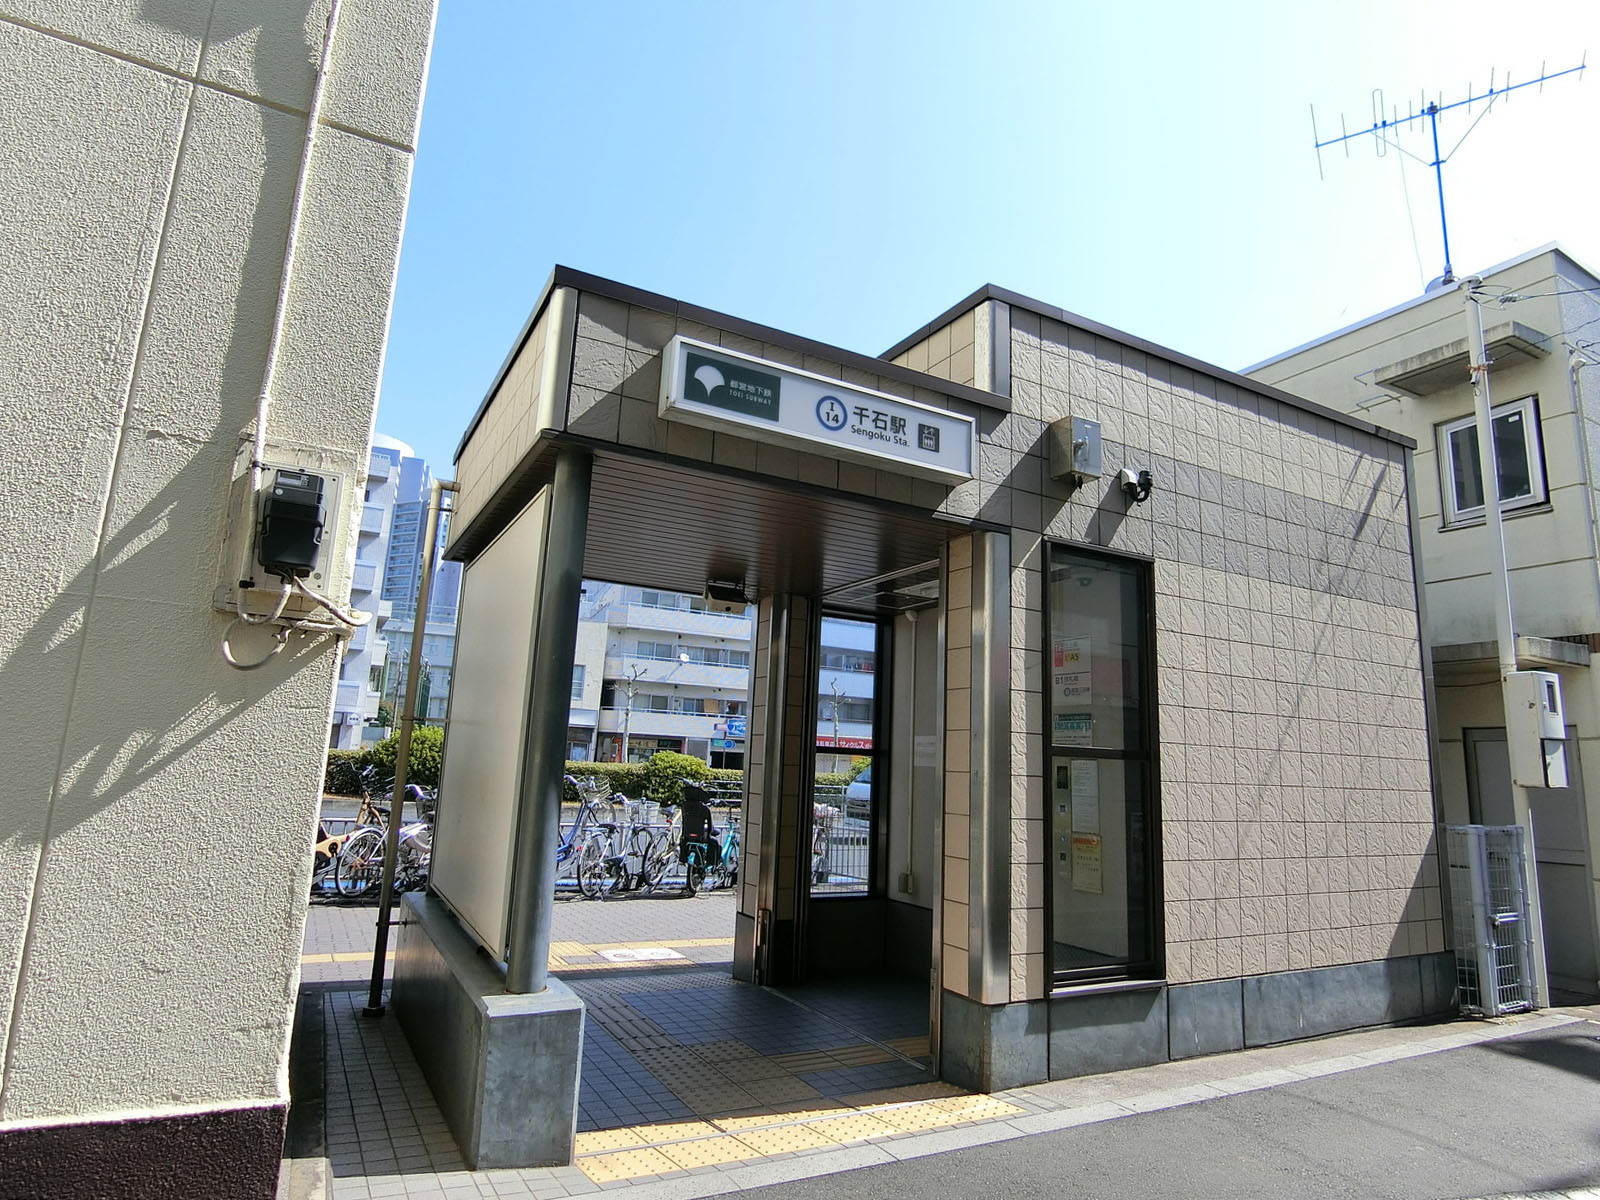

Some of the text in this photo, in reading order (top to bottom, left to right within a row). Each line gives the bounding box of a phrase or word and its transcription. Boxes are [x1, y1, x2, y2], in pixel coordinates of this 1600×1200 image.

[730, 380, 772, 397] 都営地下鉄
[729, 389, 772, 406] TOEI SUBWAY
[825, 411, 840, 424] 14
[853, 405, 907, 436] 千石駅
[850, 424, 911, 448] Sengoku Sta.
